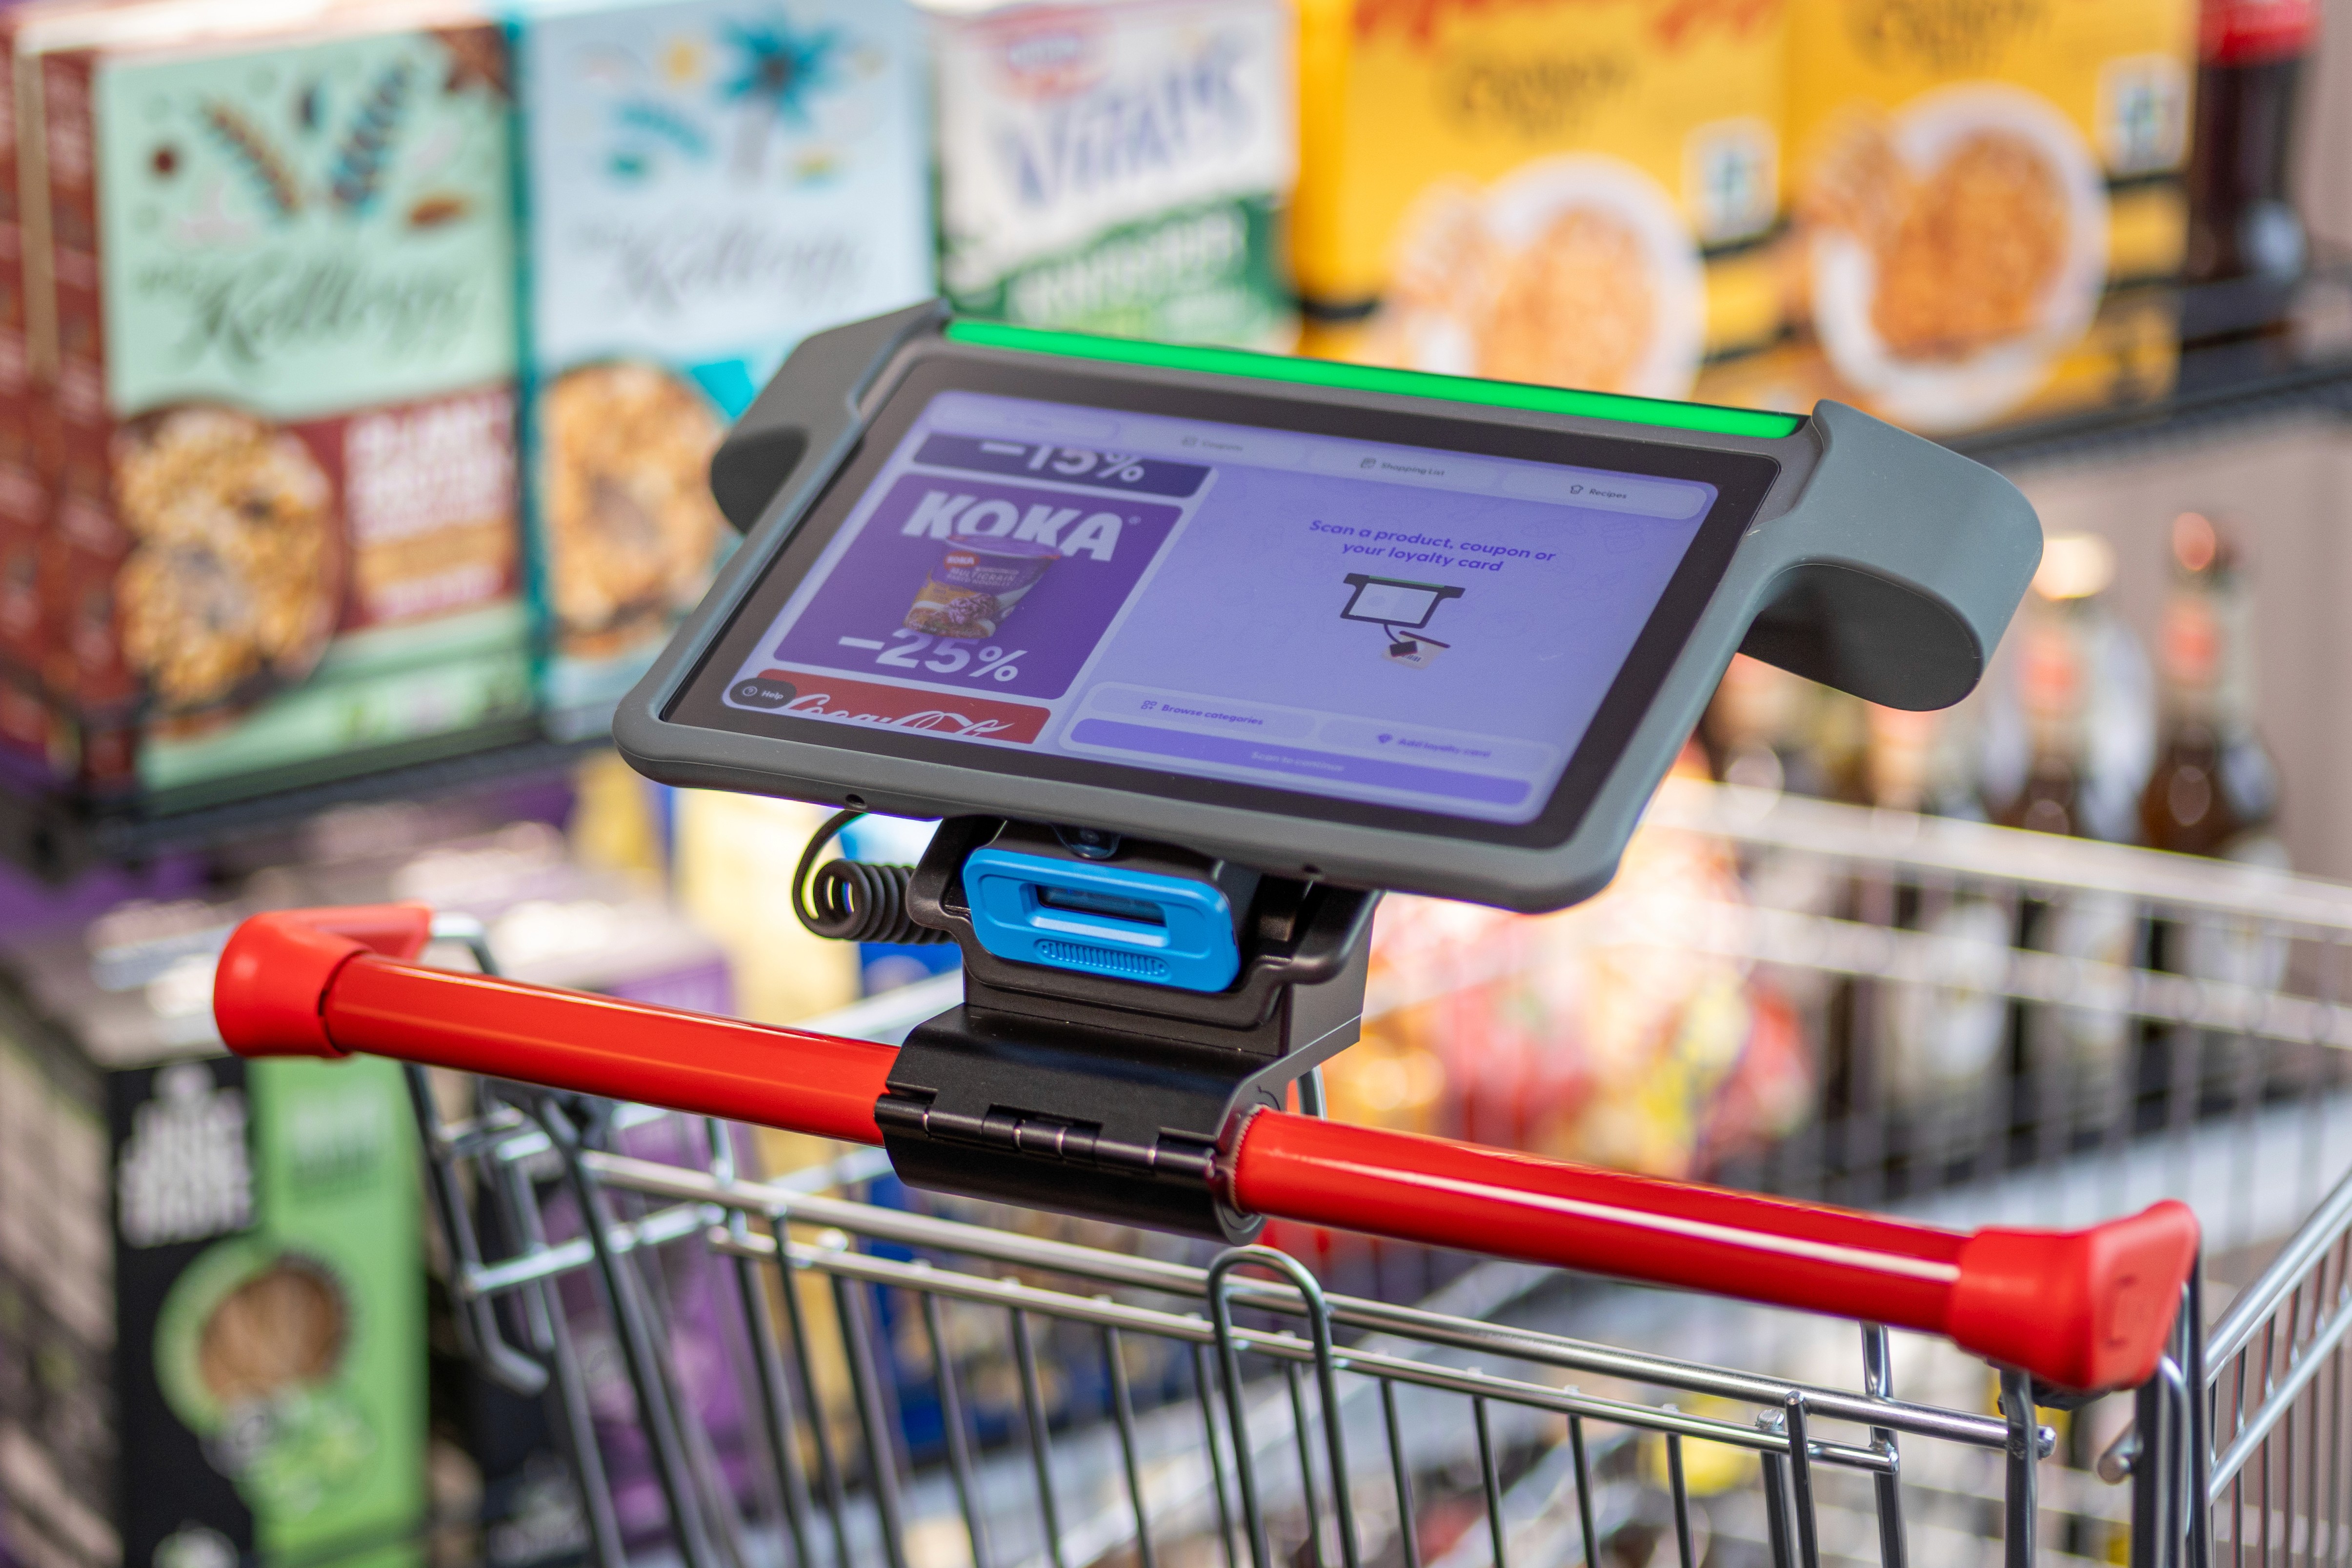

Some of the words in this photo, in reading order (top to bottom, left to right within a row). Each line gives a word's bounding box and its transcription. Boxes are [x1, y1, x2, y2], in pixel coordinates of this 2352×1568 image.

[1381, 462, 1427, 475] Shopping
[1428, 468, 1445, 476] List
[1588, 488, 1627, 500] Recipes
[901, 490, 1123, 562] KOKA
[1309, 520, 1355, 536] Scan
[1358, 528, 1372, 538] a
[1460, 541, 1531, 558] coupon
[1535, 551, 1556, 562] or
[1342, 543, 1386, 557] your
[1388, 547, 1455, 567] loyalty
[1458, 559, 1504, 572] card
[761, 690, 784, 701] Help
[1161, 704, 1203, 716] Browse
[1205, 712, 1264, 725] categories
